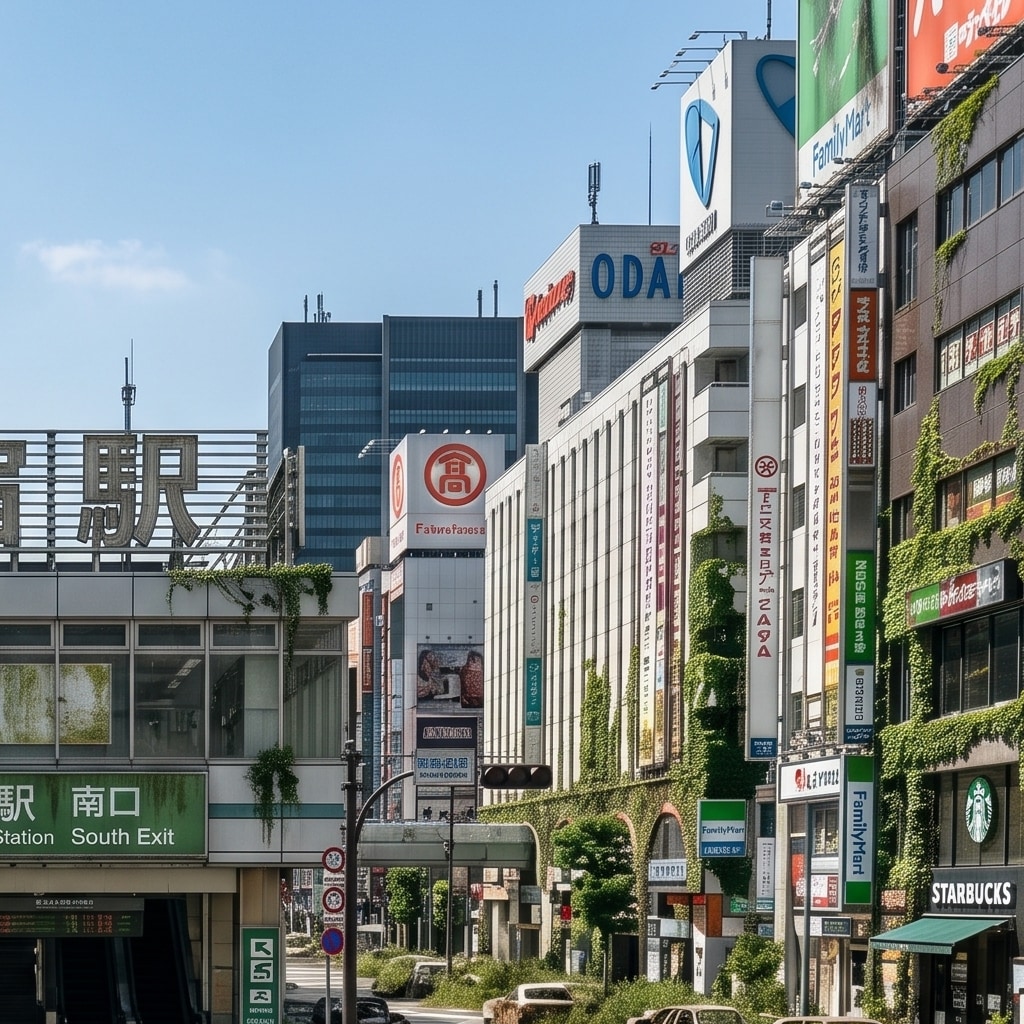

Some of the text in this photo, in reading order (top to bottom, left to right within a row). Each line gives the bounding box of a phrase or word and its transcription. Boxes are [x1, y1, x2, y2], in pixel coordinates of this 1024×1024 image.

[71, 786, 141, 818] 南口
[71, 828, 131, 846] South
[137, 828, 176, 846] Exit
[850, 790, 868, 876] FamilyMart
[932, 881, 1012, 906] STARBUCKS
